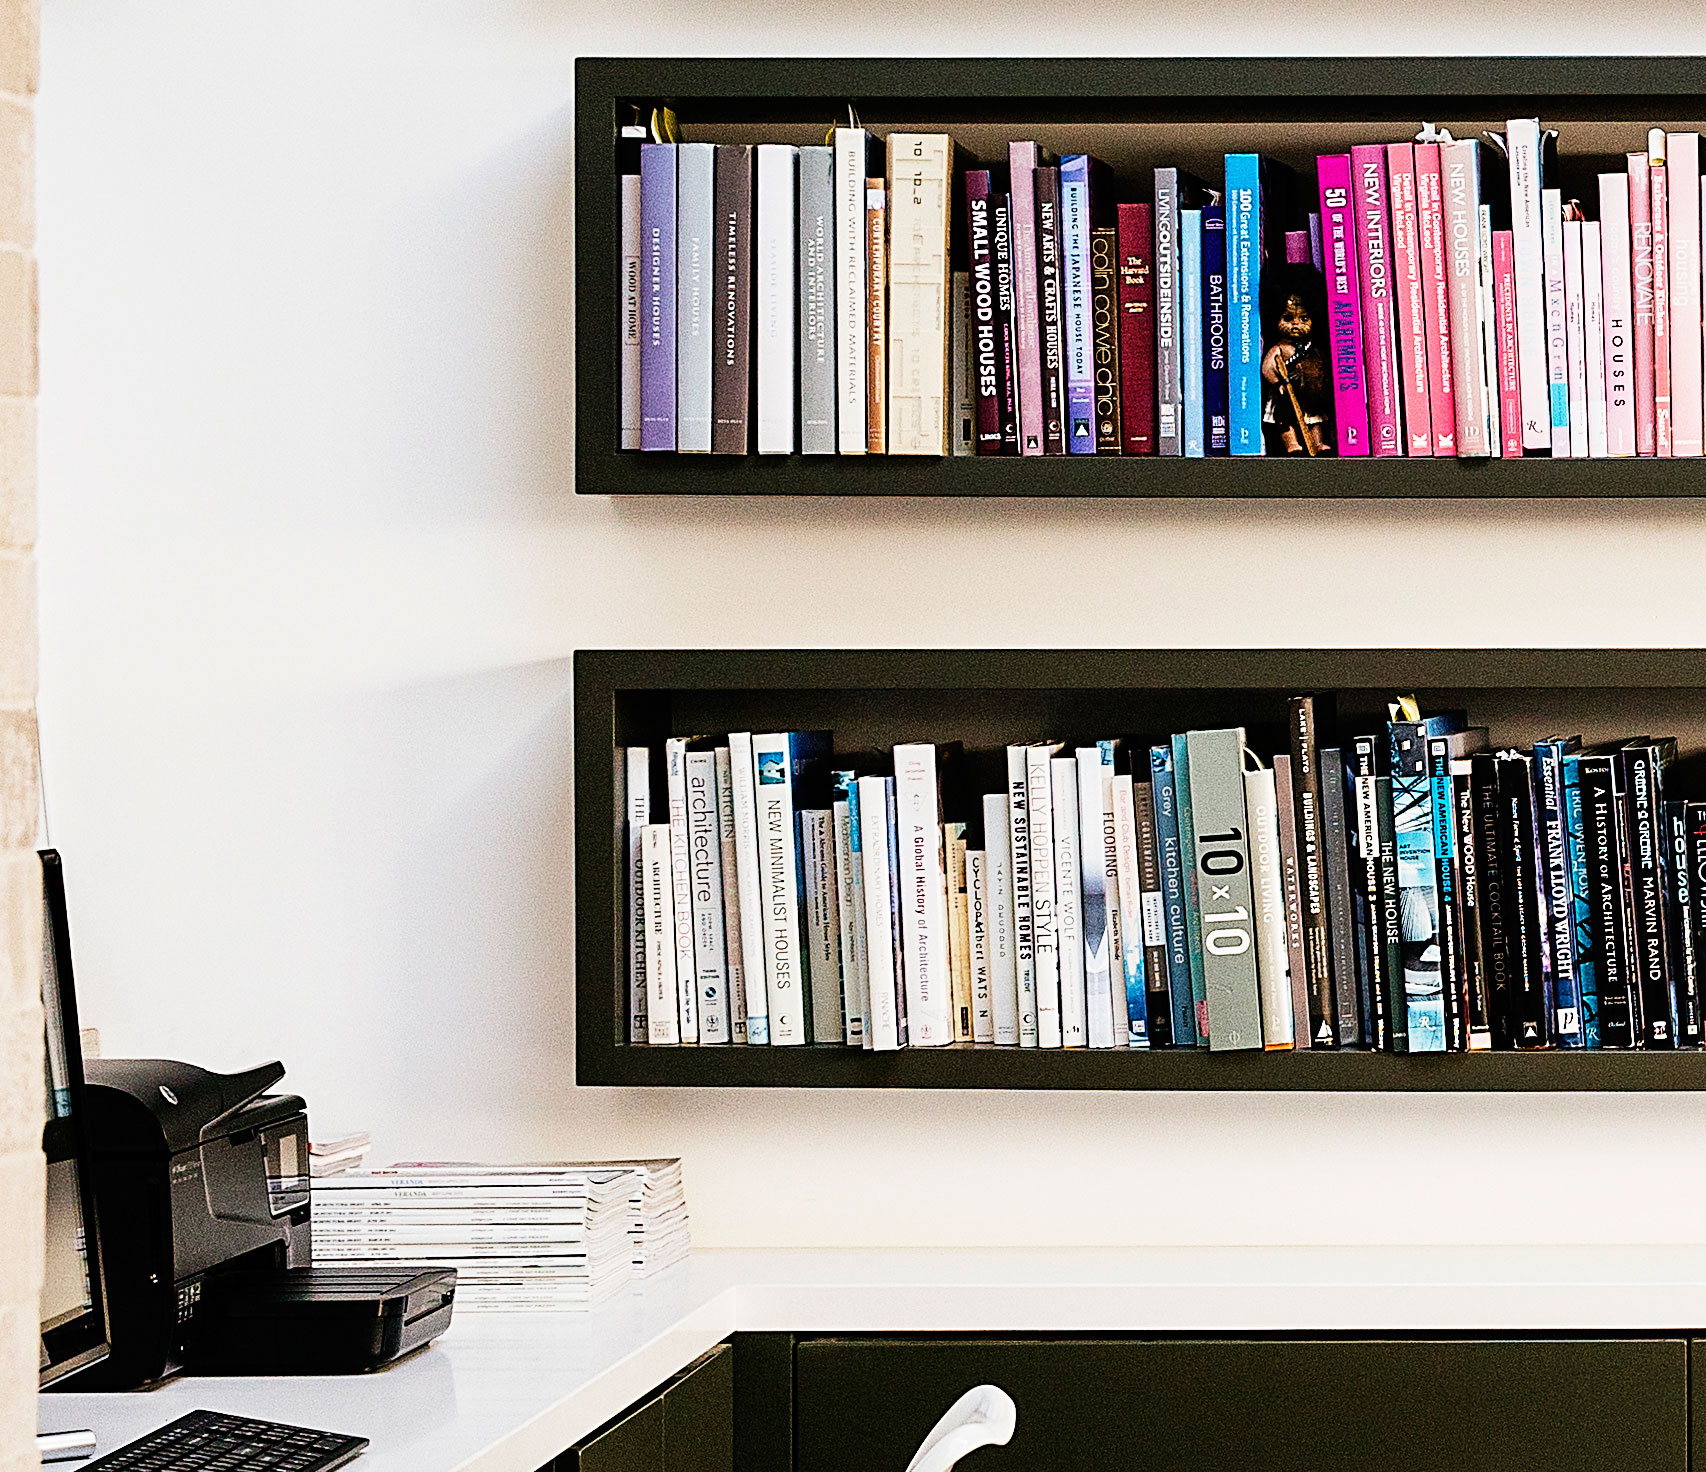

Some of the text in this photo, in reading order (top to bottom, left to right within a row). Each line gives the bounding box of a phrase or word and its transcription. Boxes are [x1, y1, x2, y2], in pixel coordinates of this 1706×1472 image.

[995, 207, 1008, 260] UNIQUE
[1239, 189, 1251, 211] 100
[1240, 212, 1250, 239] Great
[1363, 163, 1386, 298] NEW INTERIORS
[1450, 163, 1469, 276] NEW HOUSES
[628, 261, 636, 339] WOOD AT HOME
[652, 228, 660, 346] DESIGNER HOUSES
[727, 212, 736, 365] TIMELESS RENOVATIONS
[848, 151, 857, 404] BUILDING WITH RECLAIMED MATERIALS
[972, 201, 996, 396] SMALL WOOD HOUSES
[998, 264, 1010, 310] HOMES
[1042, 203, 1058, 368] NEW ARTS & CRAFTS HOUSES
[1240, 242, 1251, 292] Extensions
[1635, 223, 1654, 326] RENOVATE
[1093, 238, 1116, 416] colin cowie chic
[1209, 275, 1223, 369] BATHROOMS
[1240, 304, 1252, 363] Renovations
[672, 797, 691, 960] THE KITCHEN BOOK
[692, 778, 713, 902] architecture
[914, 837, 925, 871] Global
[1013, 782, 1032, 960] NEW SUSTAINABLE HOMES
[1030, 764, 1053, 953] KELLY HOPPEN STYLE
[1061, 836, 1075, 941] VICENTE WOLF
[1103, 812, 1118, 878] FLOORING
[1165, 837, 1179, 901] kitchen
[1199, 827, 1243, 875] 10
[1461, 790, 1476, 906] The New WOOD House
[1542, 757, 1572, 979] Essential FRANK LLOYD WRIGHT
[768, 800, 790, 989] NEW MINIMALIST HOUSES
[914, 876, 926, 914] History
[918, 919, 928, 930] of
[1169, 905, 1186, 964] culture
[1205, 906, 1250, 956] 10
[1382, 841, 1398, 944] THE NEW HOUSE
[920, 934, 930, 1002] Architecture
